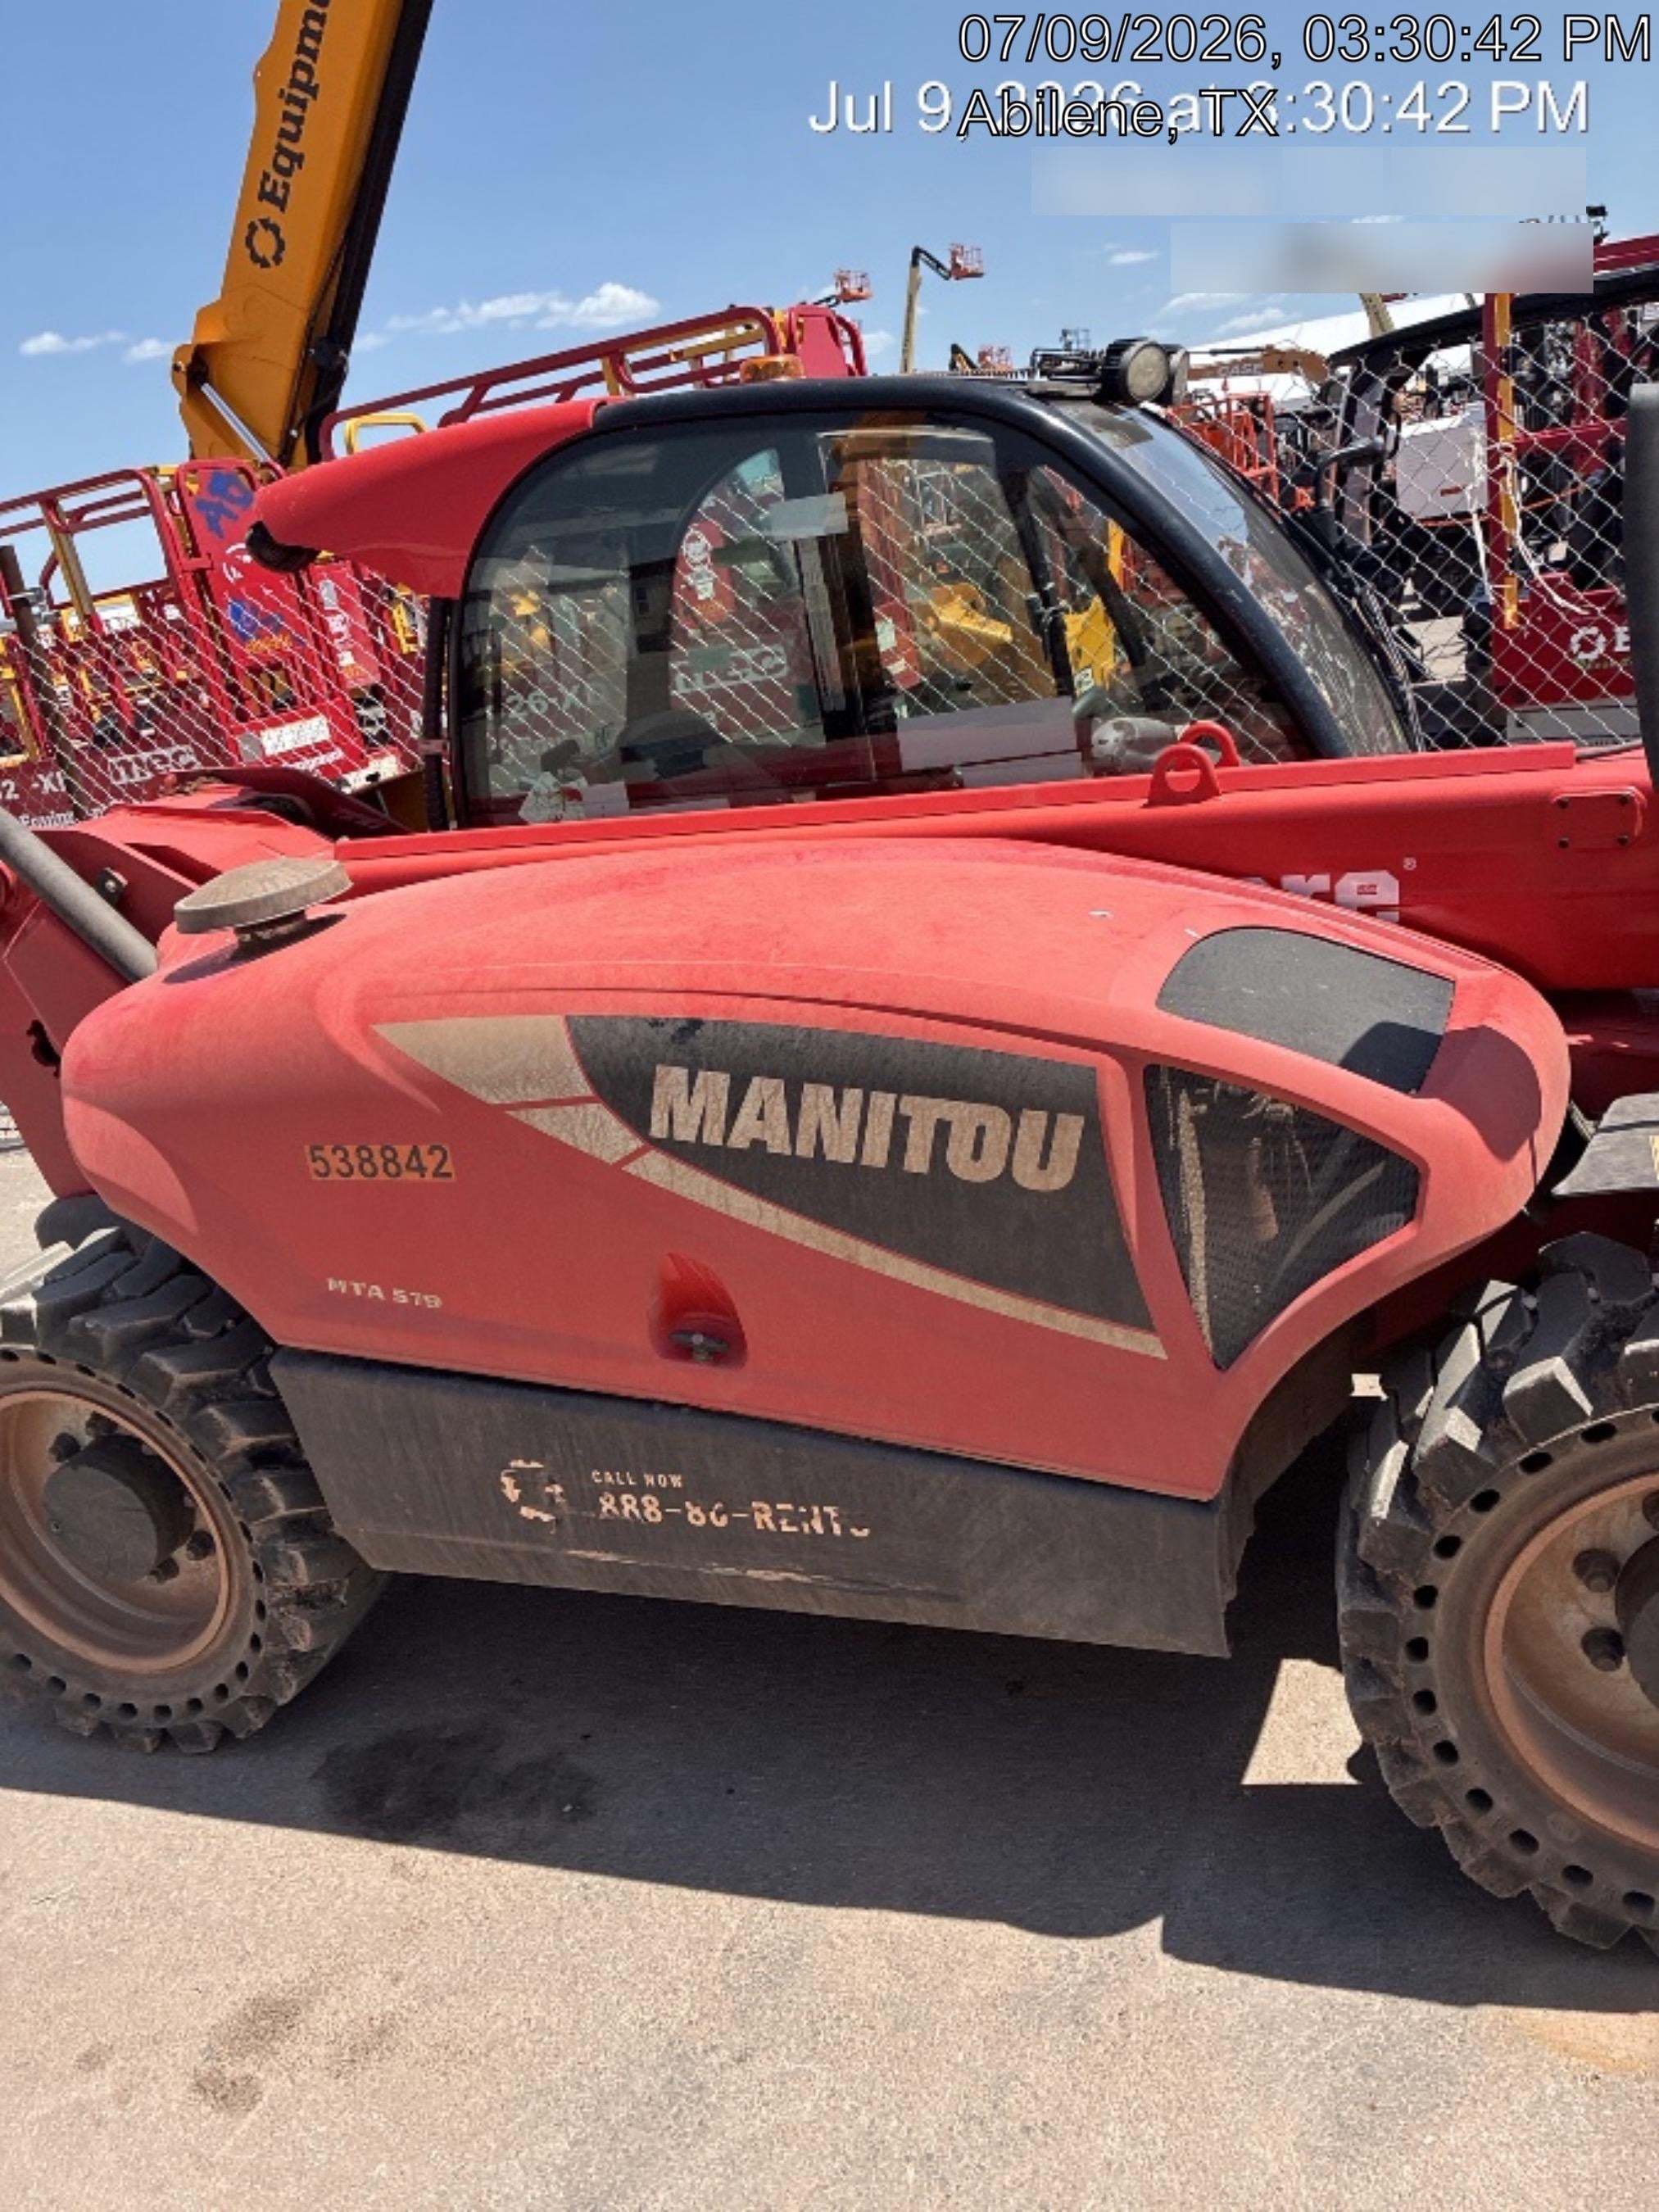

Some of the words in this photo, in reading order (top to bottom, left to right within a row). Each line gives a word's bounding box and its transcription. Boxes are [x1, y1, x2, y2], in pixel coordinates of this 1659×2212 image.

[1219, 360, 1265, 376] CASE
[649, 1064, 1085, 1193] MANITOU
[308, 1145, 453, 1178] 538842
[328, 1278, 386, 1301] MTA
[592, 1469, 637, 1487] CALL
[642, 1473, 684, 1489] NOW
